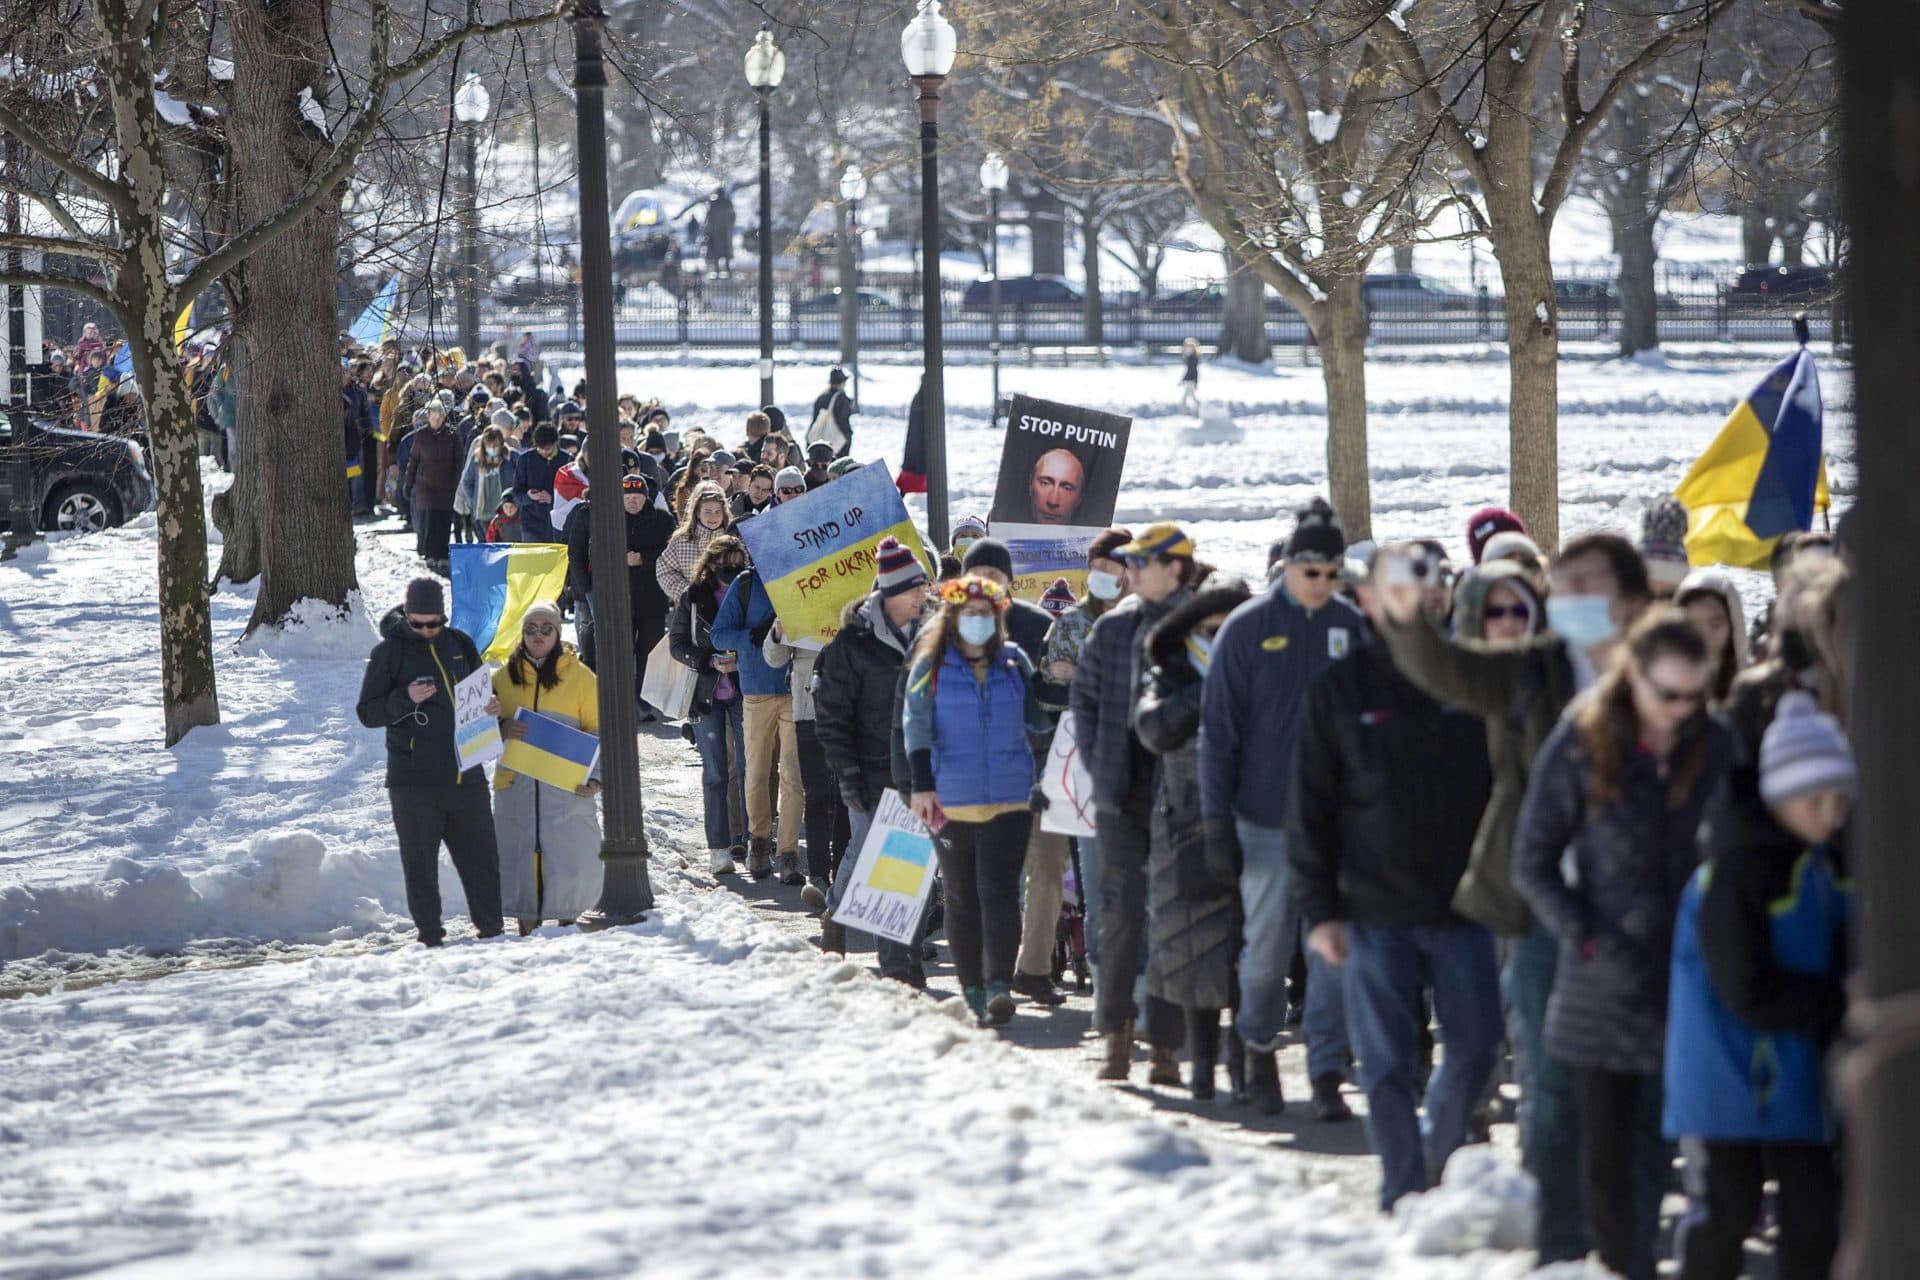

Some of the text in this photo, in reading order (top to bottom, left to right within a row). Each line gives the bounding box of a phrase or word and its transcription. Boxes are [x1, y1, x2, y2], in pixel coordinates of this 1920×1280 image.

[1019, 415, 1117, 449] STOP PUTIN
[793, 507, 863, 550] STAND UP
[796, 545, 879, 598] FOR UKRAI
